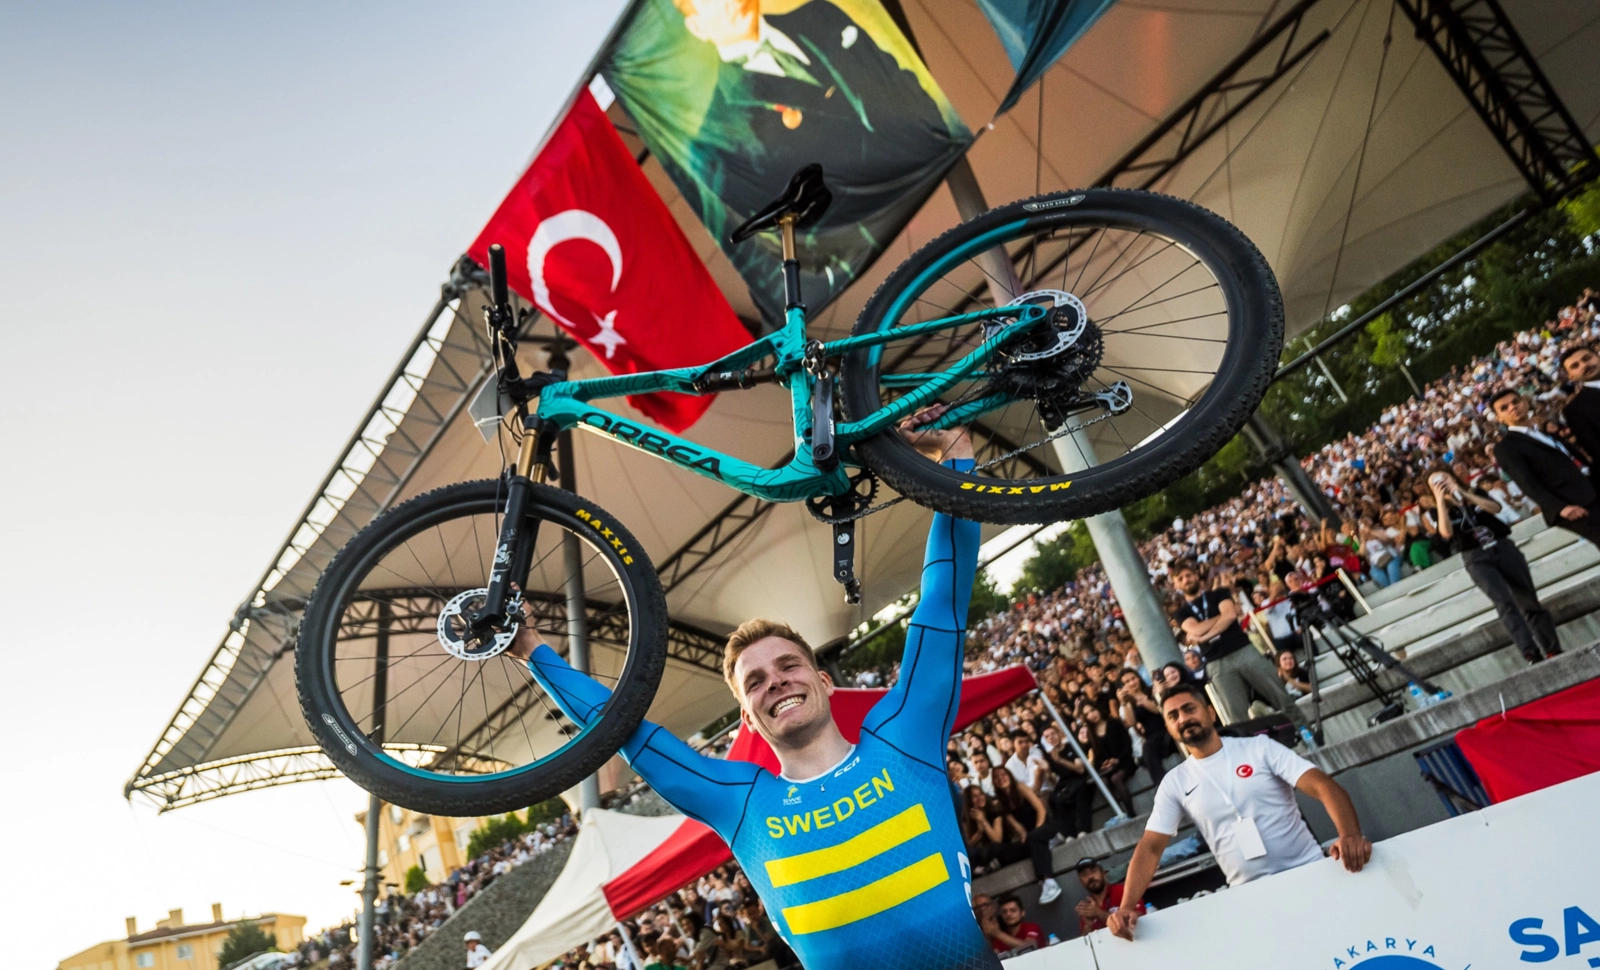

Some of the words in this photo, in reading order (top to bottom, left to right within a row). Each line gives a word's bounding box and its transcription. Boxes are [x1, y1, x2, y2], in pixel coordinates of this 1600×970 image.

[580, 411, 724, 481] ORBEA
[960, 480, 1073, 495] MAXXIS
[575, 509, 634, 565] MAXXIS
[765, 768, 895, 838] SWEDEN
[1324, 937, 1436, 970] AKARYA
